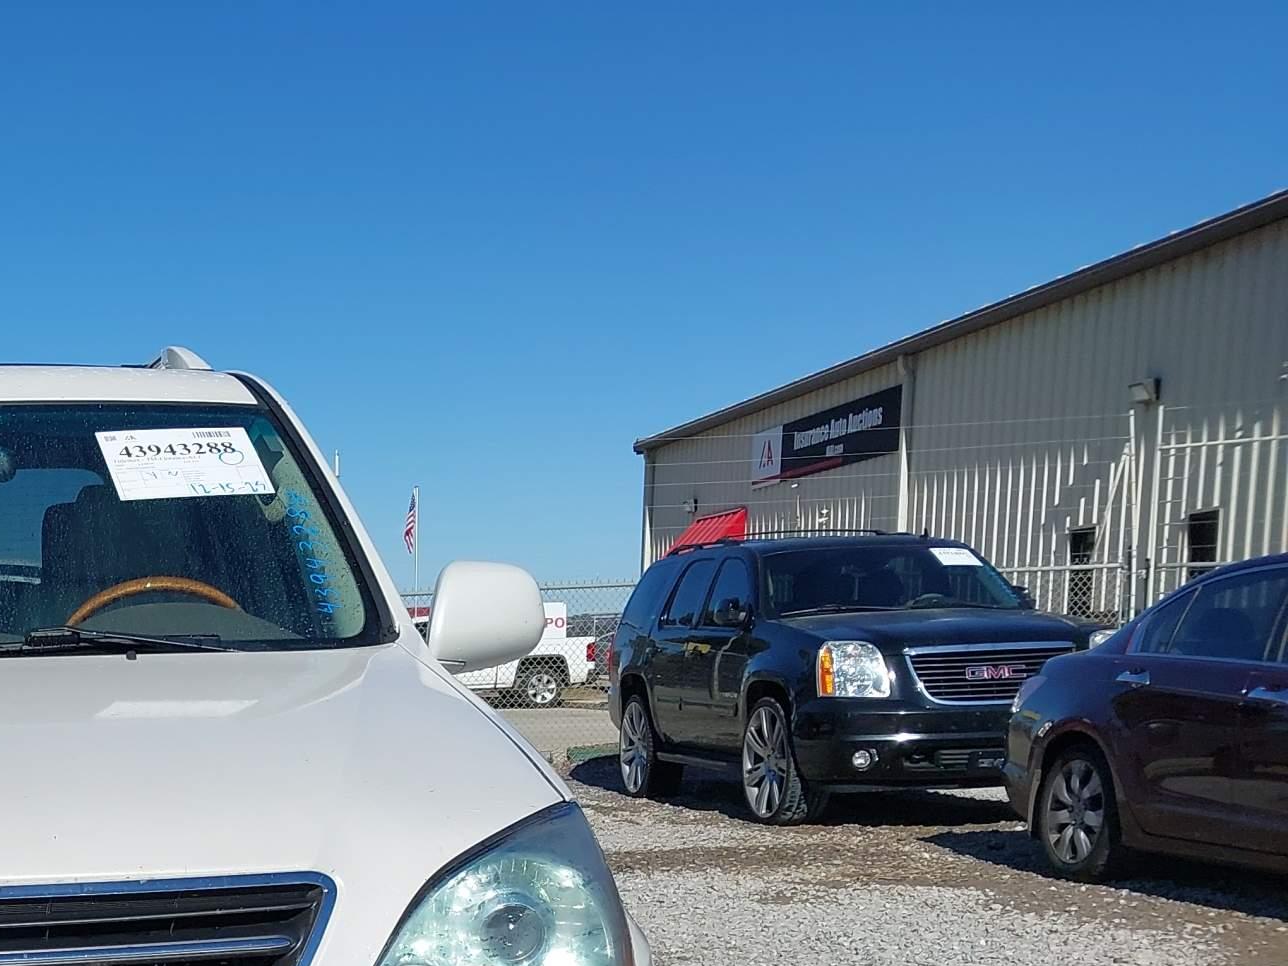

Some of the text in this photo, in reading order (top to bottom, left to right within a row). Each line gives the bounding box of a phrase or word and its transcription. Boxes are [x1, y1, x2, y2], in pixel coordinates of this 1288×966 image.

[793, 424, 829, 450] Insurance
[829, 418, 847, 439] Auto
[847, 406, 883, 434] Auctions
[119, 440, 236, 458] 43943288
[544, 617, 565, 628] PO
[965, 664, 1027, 680] GMC
